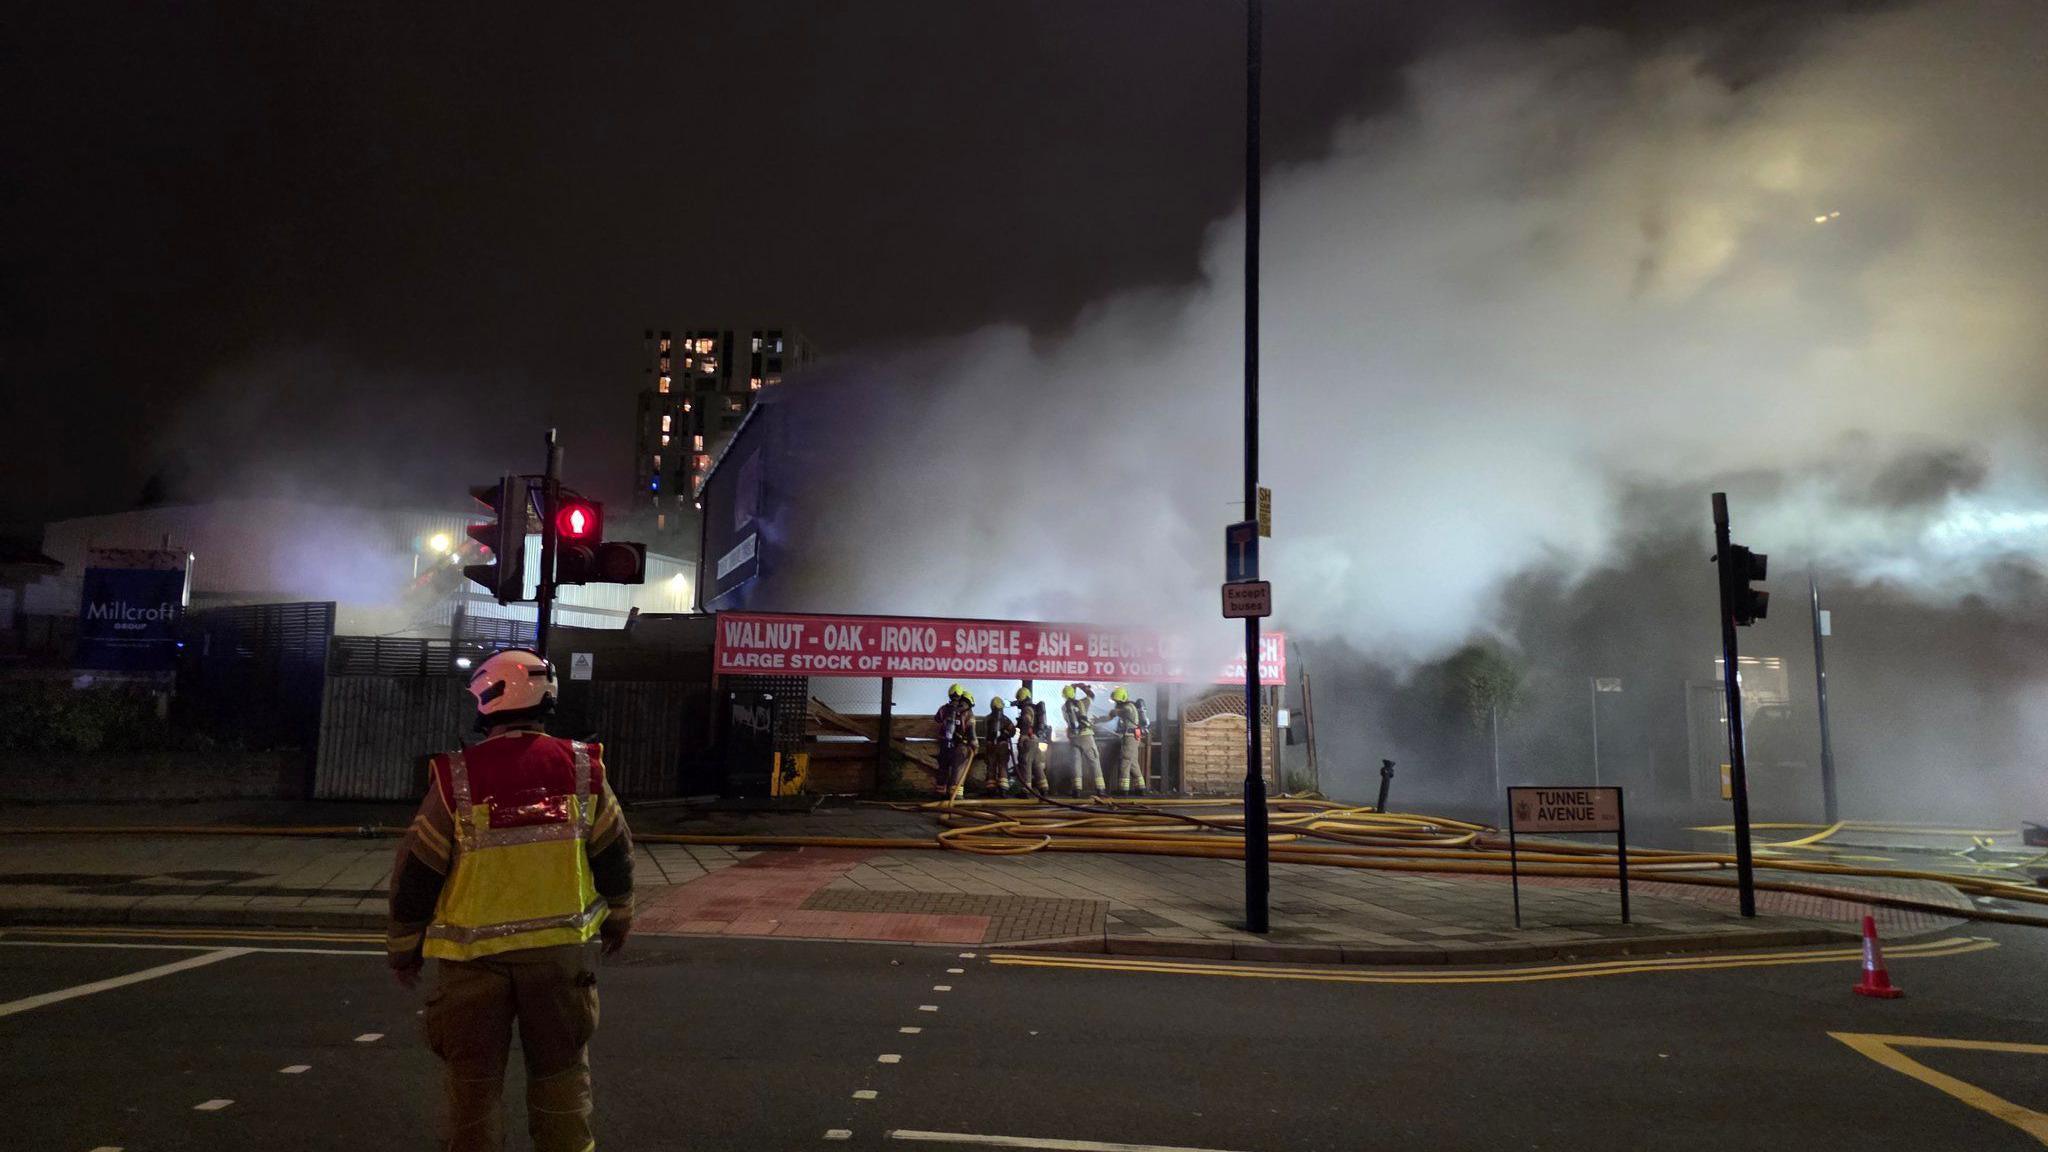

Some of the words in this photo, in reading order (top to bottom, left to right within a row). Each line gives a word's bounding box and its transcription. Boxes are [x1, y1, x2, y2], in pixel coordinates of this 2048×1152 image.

[1228, 588, 1266, 600] Except
[87, 601, 175, 620] Millcroft
[1231, 601, 1263, 611] buses
[725, 621, 804, 650] WALNUT
[824, 624, 863, 651] OAK
[881, 626, 937, 653] IROKO
[955, 628, 1020, 655] SAPELE
[1037, 632, 1070, 656] ASH
[722, 652, 785, 668] LARGE
[791, 654, 852, 669] STOCK
[859, 656, 882, 670] OF
[887, 657, 997, 672] HARDWOODS
[1002, 659, 1088, 674] MACHINED
[1094, 661, 1114, 674] TO
[1119, 662, 1162, 676] YOUR
[1536, 791, 1594, 805] TUNNEL
[1537, 807, 1595, 820] AVENUE
